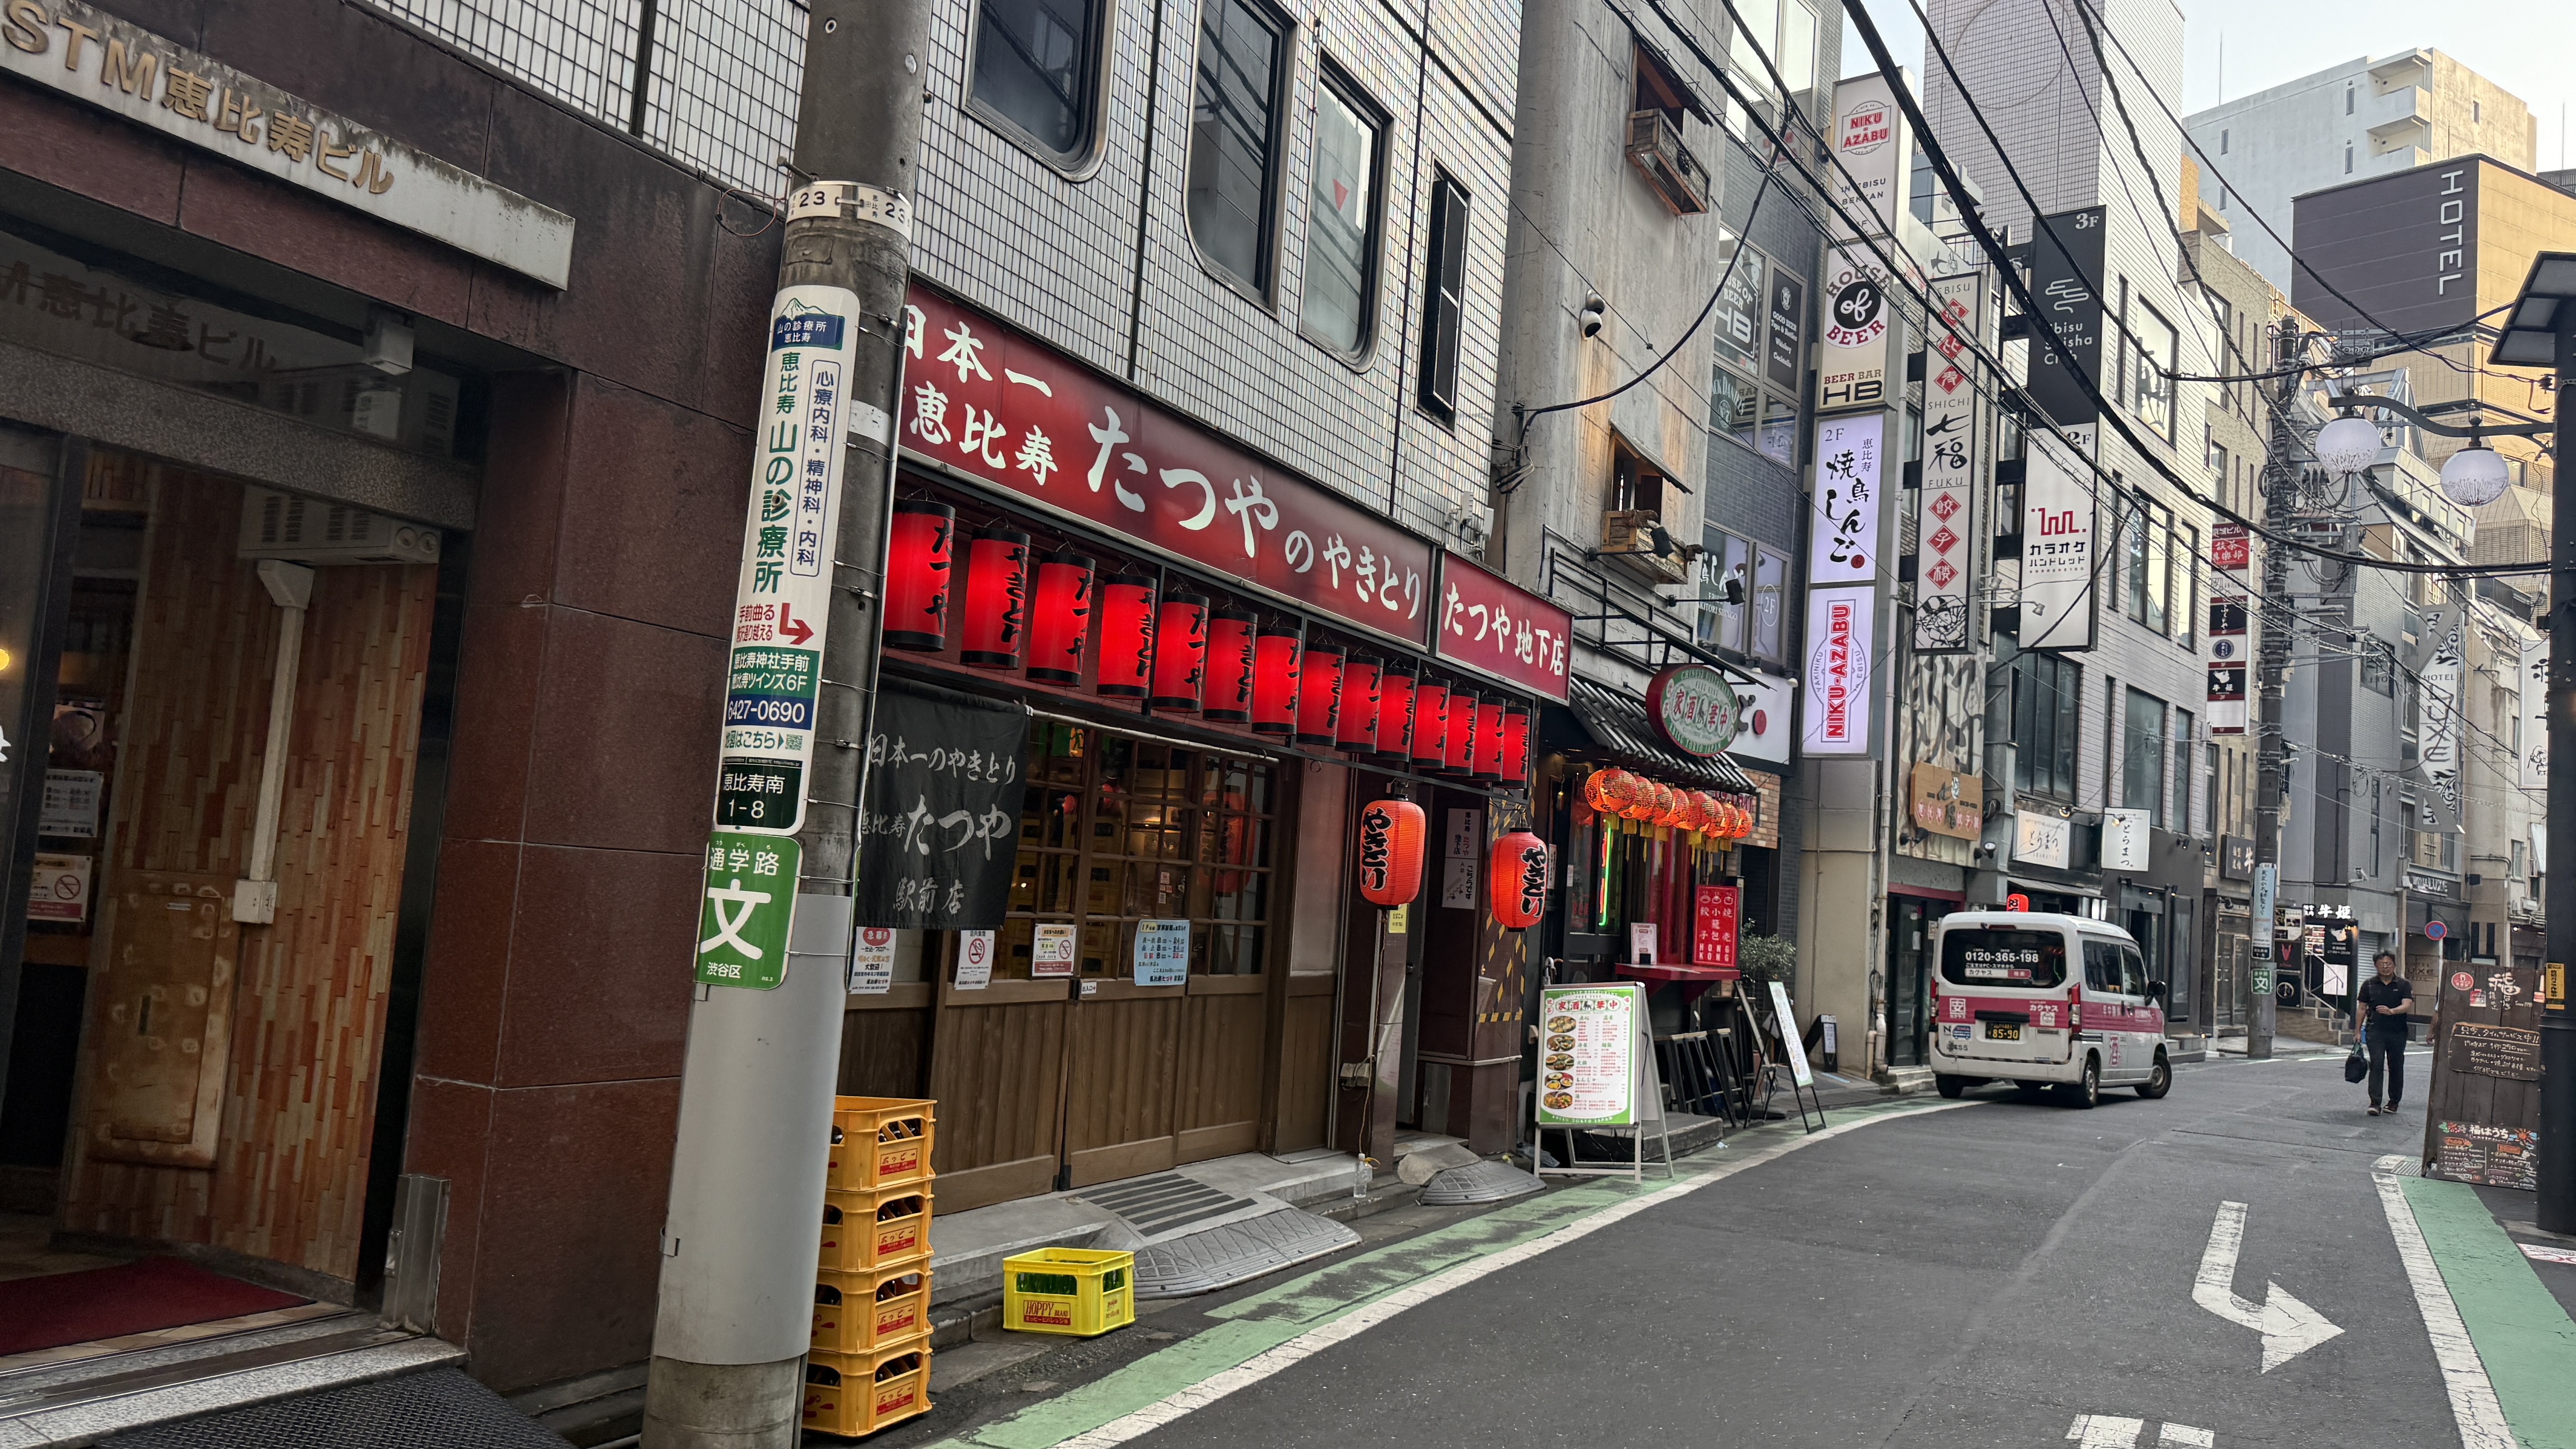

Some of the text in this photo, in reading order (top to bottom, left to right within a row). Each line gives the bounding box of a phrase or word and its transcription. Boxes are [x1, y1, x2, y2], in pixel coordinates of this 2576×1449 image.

[1850, 111, 1883, 130] NIKU
[1843, 127, 1888, 148] AZABU
[2075, 213, 2099, 229] 3F
[2438, 170, 2464, 296] HOTEL
[1826, 262, 1890, 299] HOUSE
[1723, 287, 1744, 311] BEER
[1742, 287, 1753, 305] OF
[1840, 288, 1872, 322] of
[777, 321, 827, 335] 山の診療所
[1772, 311, 1797, 332] GOOD BEER
[1826, 319, 1886, 345] BEER
[2050, 322, 2084, 335] bisu
[784, 332, 811, 343] 恵比寿
[904, 304, 1052, 397] 日本一
[2044, 349, 2077, 365] Clb
[1824, 369, 1881, 385] BEER BAR
[1822, 380, 1883, 406] HB
[1928, 397, 1970, 410] SHICHI
[910, 380, 1058, 487] 恵比寿
[1825, 428, 1845, 442] 2F
[2067, 431, 2092, 446] 2F
[1861, 438, 1873, 473] 恵比寿
[752, 352, 800, 594] 恵比寿山の診療所
[796, 370, 834, 567] 心療内科・精神科・内科
[1928, 476, 1963, 488] FUKU
[2029, 541, 2086, 556] カラオケ
[2029, 556, 2085, 567] ハンドレッド
[739, 603, 775, 623] 手前曲る
[1444, 583, 1564, 676] たつや地下店
[733, 652, 810, 672] 恵比寿神社手前
[1813, 651, 1823, 693] YAKINIKU
[1826, 604, 1851, 738] NIKU-AZABU
[1854, 650, 1863, 679] EBISU
[727, 700, 805, 724] 6427-0690
[869, 733, 1016, 785] 日本一のやきとり
[723, 773, 786, 795] 恵比寿南
[729, 800, 764, 819] 1-8
[904, 794, 1012, 861] たつや
[1361, 806, 1394, 892] やきとり
[2121, 824, 2130, 866] とらまつ
[709, 847, 780, 876] 通学路
[1520, 844, 1548, 918] やきとり
[893, 876, 964, 915] 駅前店
[700, 878, 772, 960] 文
[1965, 951, 2039, 963] 0120-365-198
[707, 961, 741, 979] 渋谷区
[2029, 1004, 2059, 1012] カクヤス
[1992, 1029, 2019, 1039] 85-90
[2469, 1124, 2509, 1139] 福はうち
[1026, 1301, 1054, 1316] HOPPY
